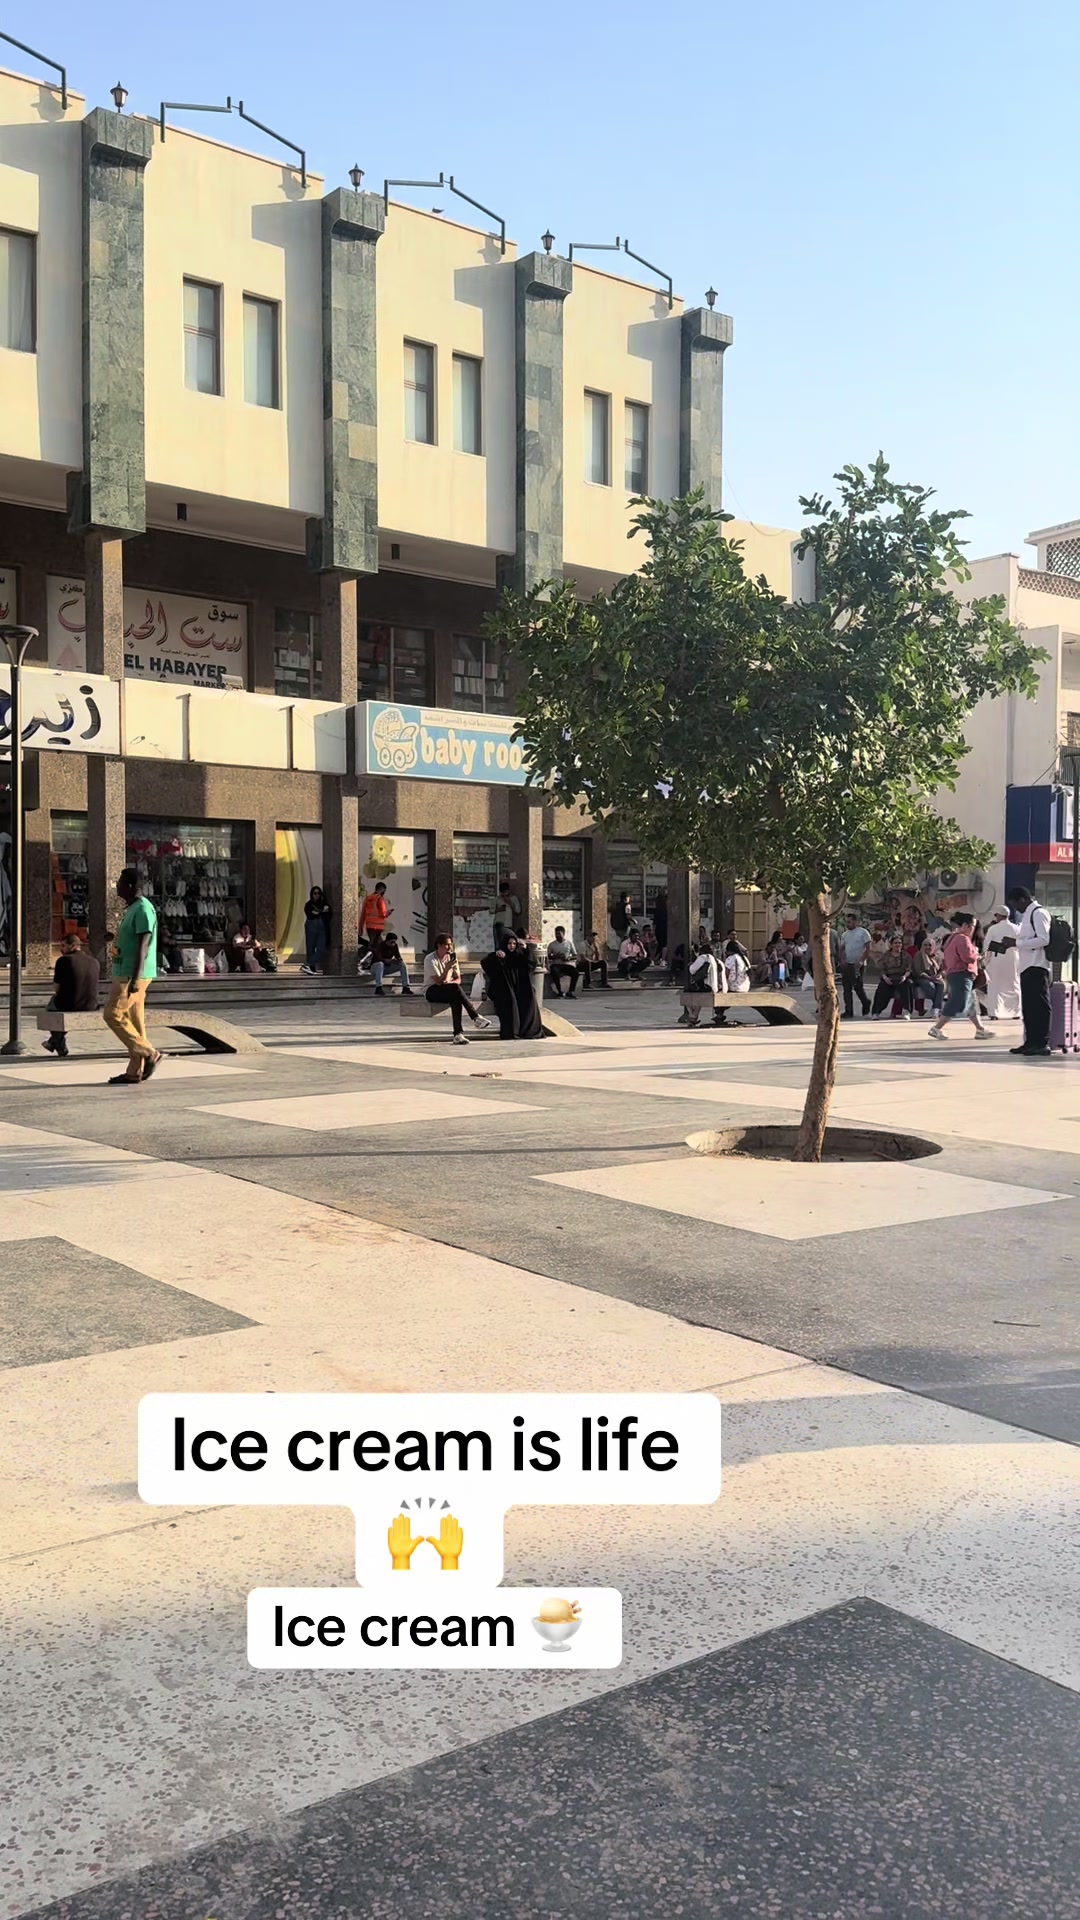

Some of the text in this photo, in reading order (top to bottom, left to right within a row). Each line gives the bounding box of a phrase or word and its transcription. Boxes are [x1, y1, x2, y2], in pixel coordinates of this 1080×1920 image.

[208, 604, 239, 622] سوق
[123, 653, 145, 669] EL
[419, 726, 477, 776] baby
